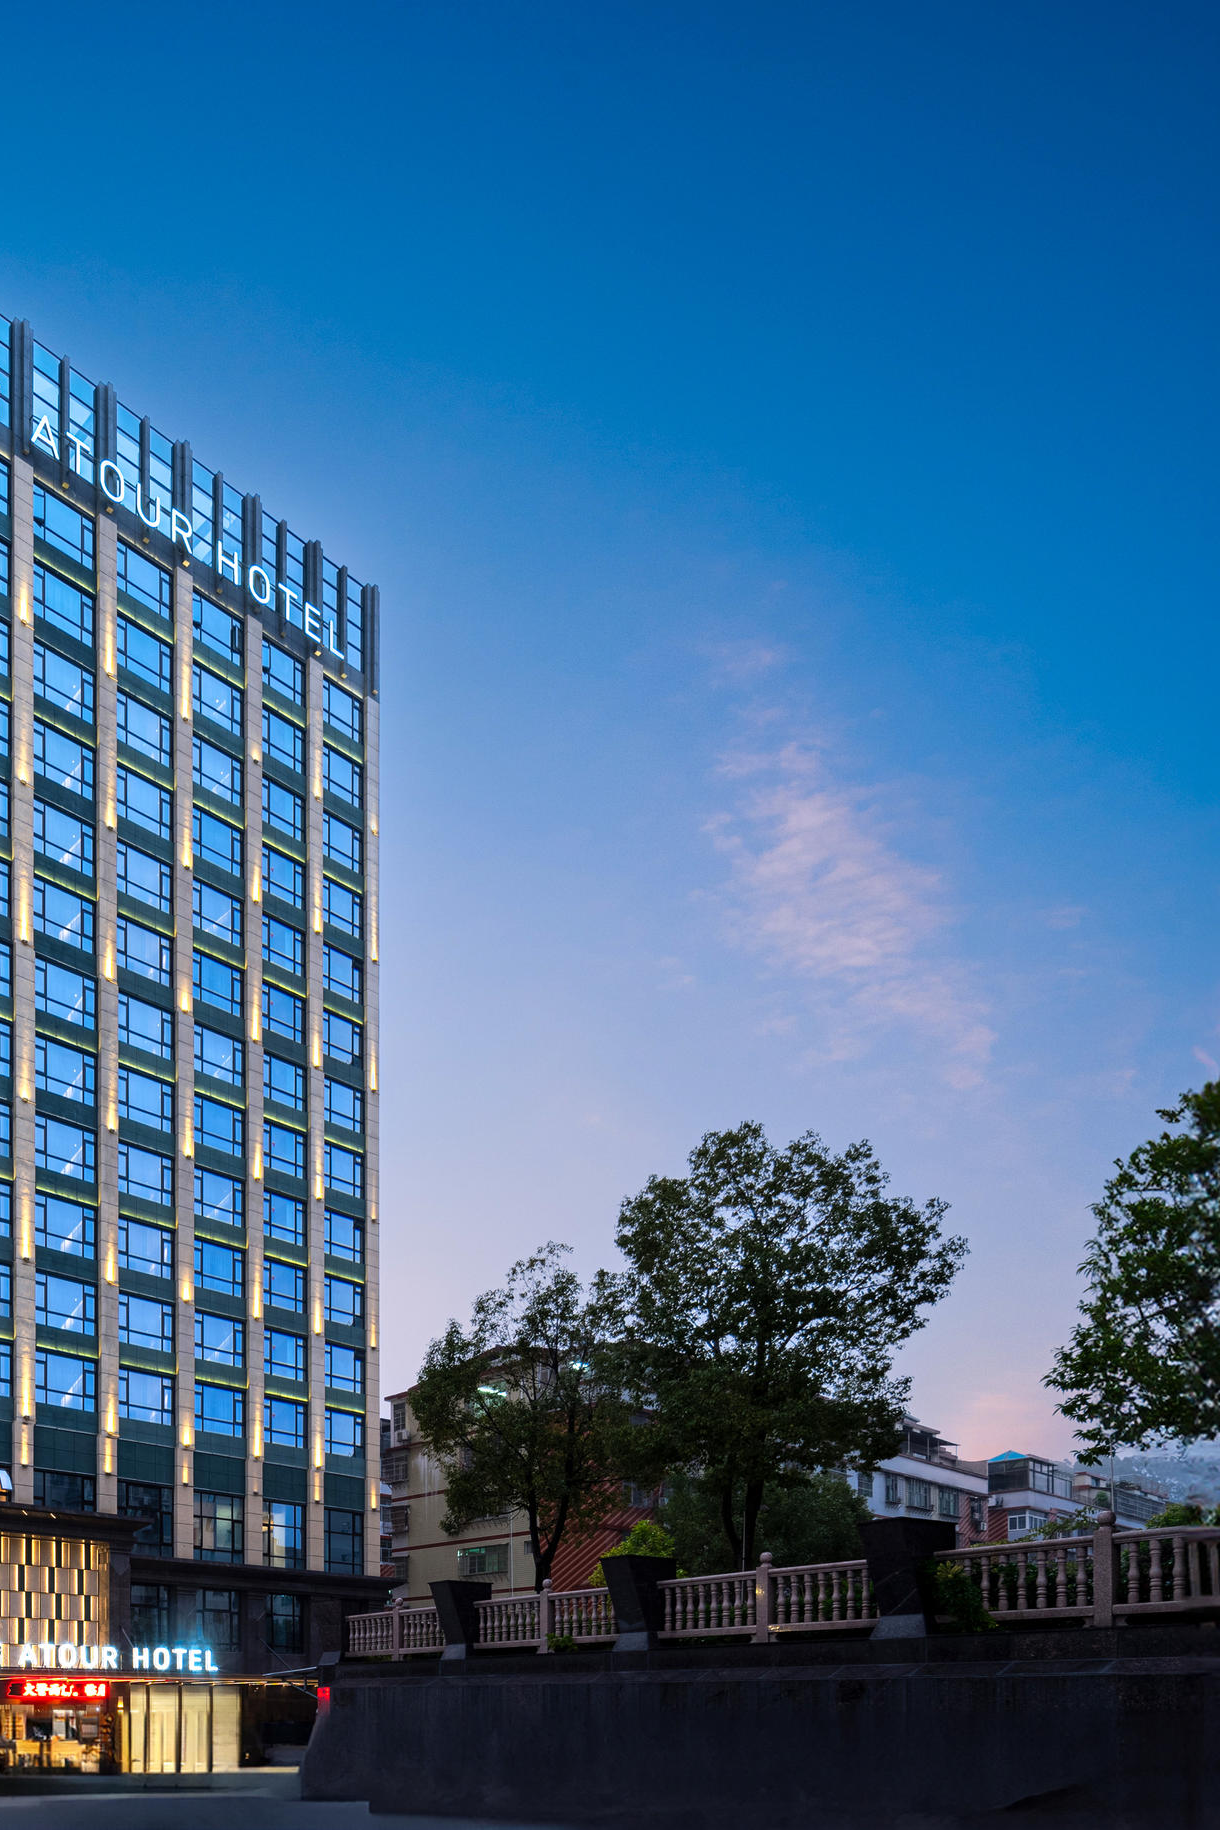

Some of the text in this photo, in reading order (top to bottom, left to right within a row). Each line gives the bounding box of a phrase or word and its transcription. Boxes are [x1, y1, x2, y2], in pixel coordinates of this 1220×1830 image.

[30, 414, 346, 661] ATOUR HOTEL
[17, 1642, 220, 1673] ATOUR HOTEL
